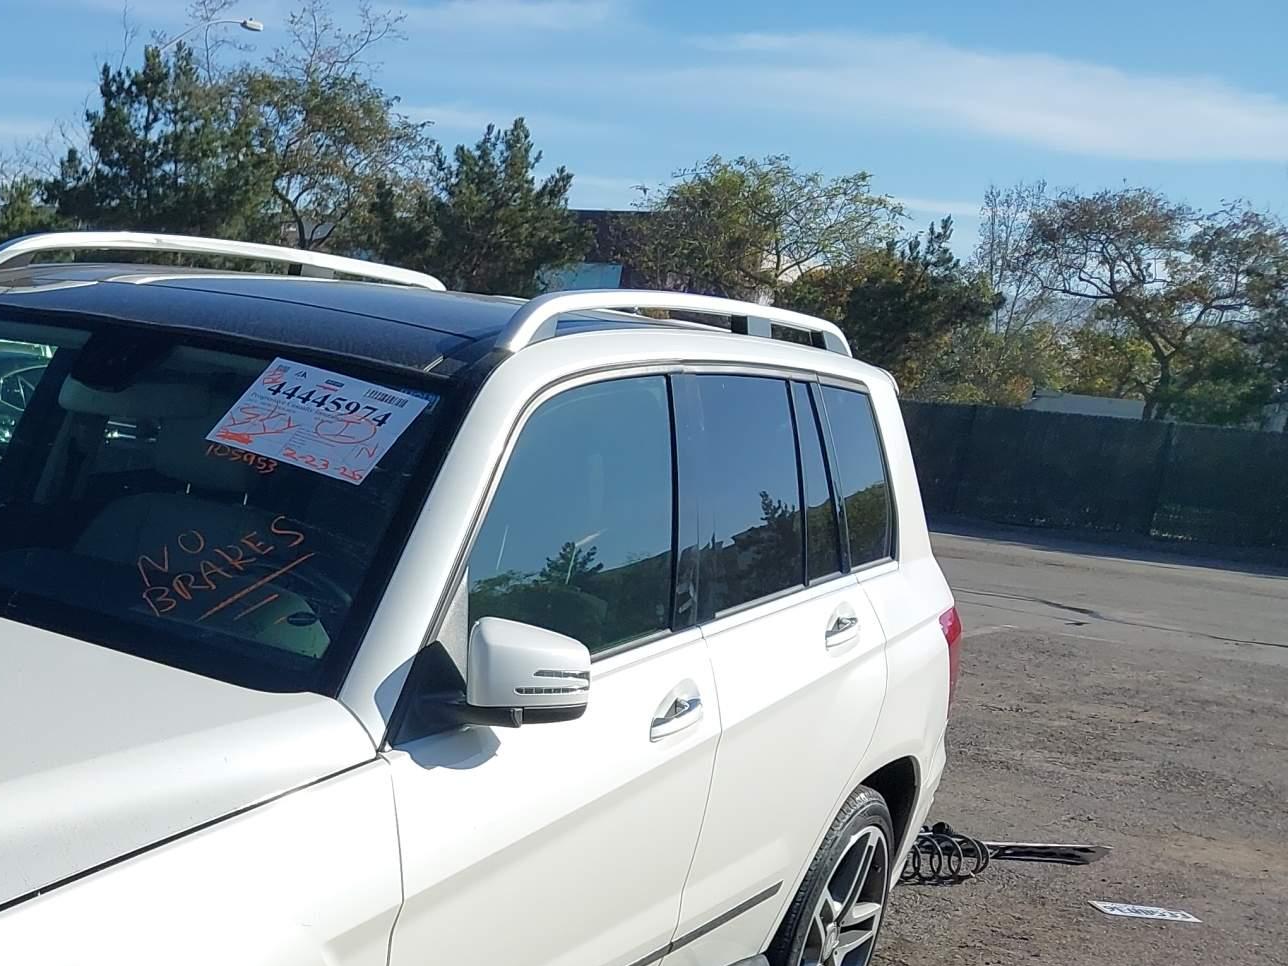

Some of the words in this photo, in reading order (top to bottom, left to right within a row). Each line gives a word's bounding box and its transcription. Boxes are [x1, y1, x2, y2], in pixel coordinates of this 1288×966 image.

[267, 381, 392, 427] 44445974
[137, 529, 205, 587] NO
[142, 515, 304, 617] BRAKES
